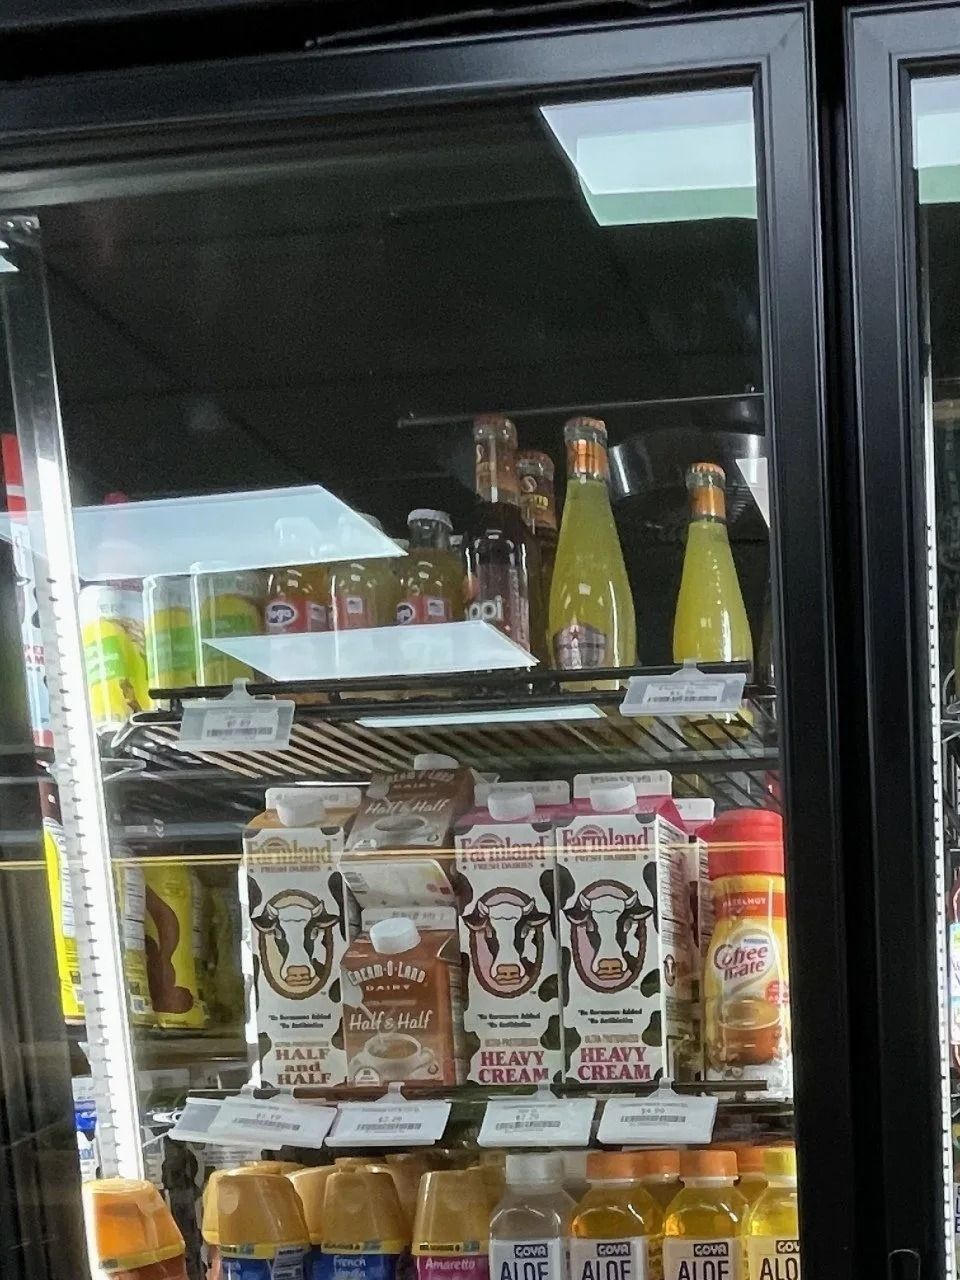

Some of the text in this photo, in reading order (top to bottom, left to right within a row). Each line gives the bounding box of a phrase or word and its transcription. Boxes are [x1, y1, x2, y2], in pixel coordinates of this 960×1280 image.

[562, 828, 652, 855] Farmland
[714, 943, 768, 971] Coffee
[349, 1012, 382, 1030] Half
[397, 1010, 434, 1029] Half
[276, 1048, 330, 1061] HALF
[481, 1051, 545, 1067] HEAVY
[580, 1047, 647, 1063] HEAVY
[284, 1062, 321, 1073] and
[577, 1064, 652, 1081] CREAM
[277, 1073, 332, 1085] HALF
[478, 1068, 549, 1084] CREAM
[514, 1244, 548, 1258] GOYA
[597, 1243, 631, 1256] GOYA
[694, 1242, 728, 1256] GOYA
[425, 1259, 476, 1270] Amaretto
